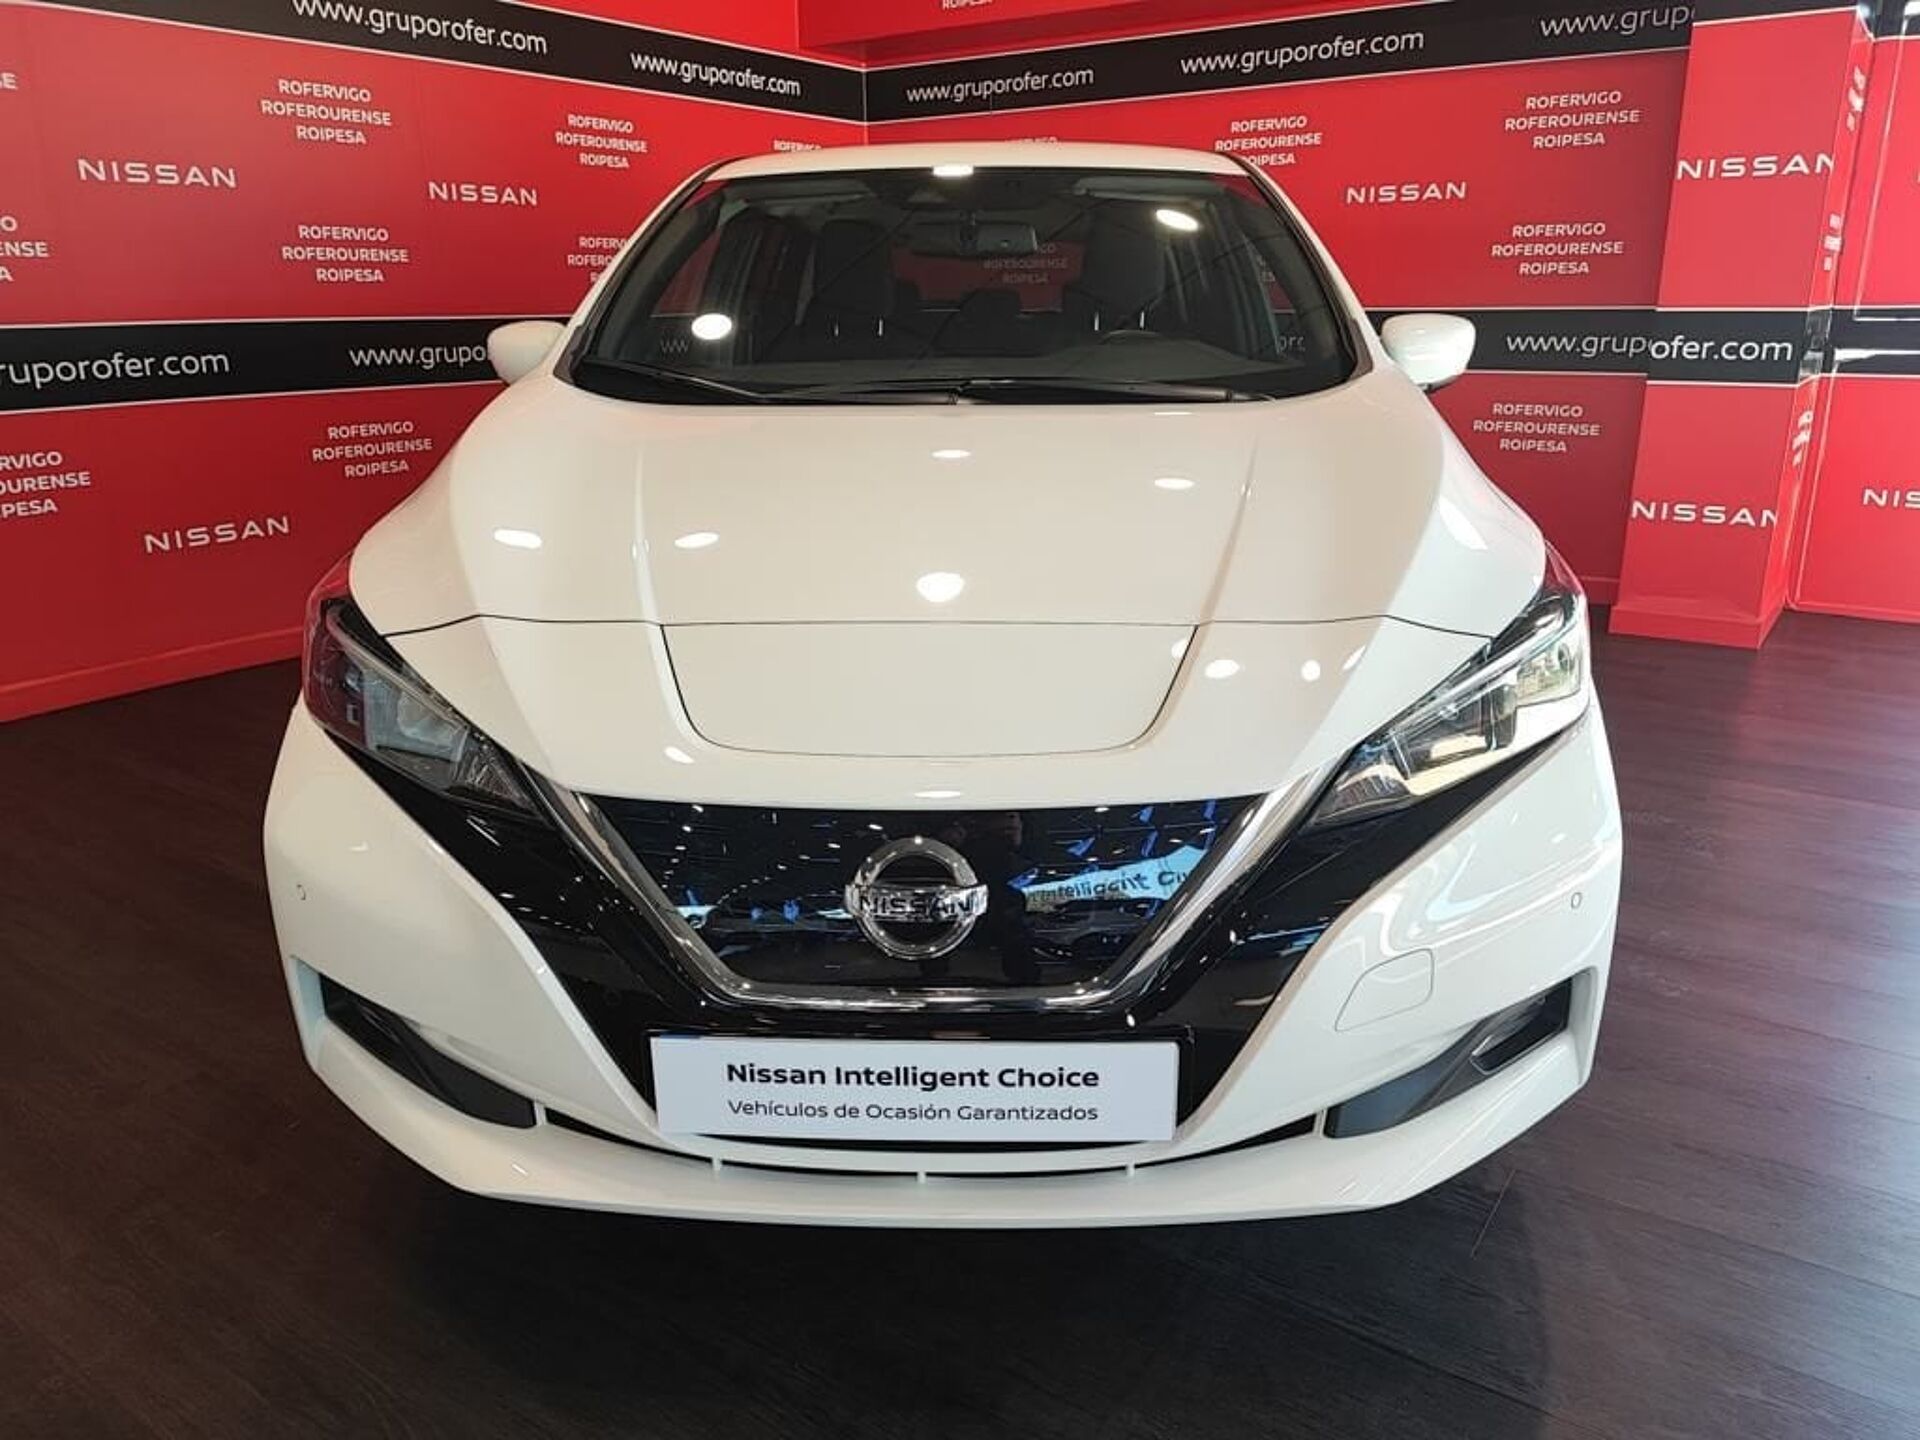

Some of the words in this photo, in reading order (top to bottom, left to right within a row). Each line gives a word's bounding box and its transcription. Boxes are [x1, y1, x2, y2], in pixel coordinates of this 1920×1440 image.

[291, 0, 549, 54] www.gruporofer.com
[1180, 31, 1425, 75] www.gruporofer.com
[630, 52, 801, 97] www.gruporofer.com
[278, 78, 372, 103] ROFERVIGO
[906, 68, 1095, 103] www.gruporofer.com
[1525, 90, 1622, 110] ROFERVIGO
[260, 99, 393, 126] ROFEROURENSE
[1504, 109, 1641, 131] ROFEROURENSE
[567, 113, 634, 134] ROFERVIGO
[1230, 115, 1308, 134] ROFERVIGO
[295, 124, 367, 145] ROIPESA
[1214, 132, 1322, 151] ROFEROURENSE
[1532, 131, 1606, 149] ROIPESA
[579, 152, 630, 169] ROIPESA
[1242, 152, 1296, 166] OIPESA
[1676, 153, 1834, 181] NISSAN
[77, 158, 237, 189] NISSAN
[428, 180, 538, 206] NISSAN
[1346, 181, 1467, 204] NISSAN
[298, 224, 390, 242] ROFERVIGO
[1511, 222, 1606, 239] ROFERVIGO
[578, 236, 631, 250] ROFERV
[1491, 240, 1624, 258] ROFEROURENSE
[281, 245, 410, 263] ROFEROURENSE
[315, 267, 385, 283] ROIPESA
[1518, 261, 1590, 276] ROIPESA
[350, 345, 487, 370] www.grupo
[0, 352, 231, 390] uporofer.com
[1493, 403, 1584, 418] ROFERVIGO
[327, 421, 414, 440] ROFERVIGO
[1473, 420, 1600, 436] ROFEROURENSE
[312, 438, 433, 461] ROFEROURENSE
[1500, 438, 1567, 453] ROIPESA
[344, 460, 409, 478] ROIPESA
[1631, 501, 1777, 528] NISSAN
[144, 515, 290, 554] NISSAN
[858, 892, 973, 917] NISSAN
[727, 1063, 826, 1085] Nissan
[835, 1066, 990, 1092] Intelligent
[997, 1067, 1100, 1088] Choice
[728, 1100, 828, 1117] Vehículos
[834, 1103, 860, 1118] de
[865, 1104, 951, 1120] Ocasión
[957, 1105, 1099, 1121] Garantizados
